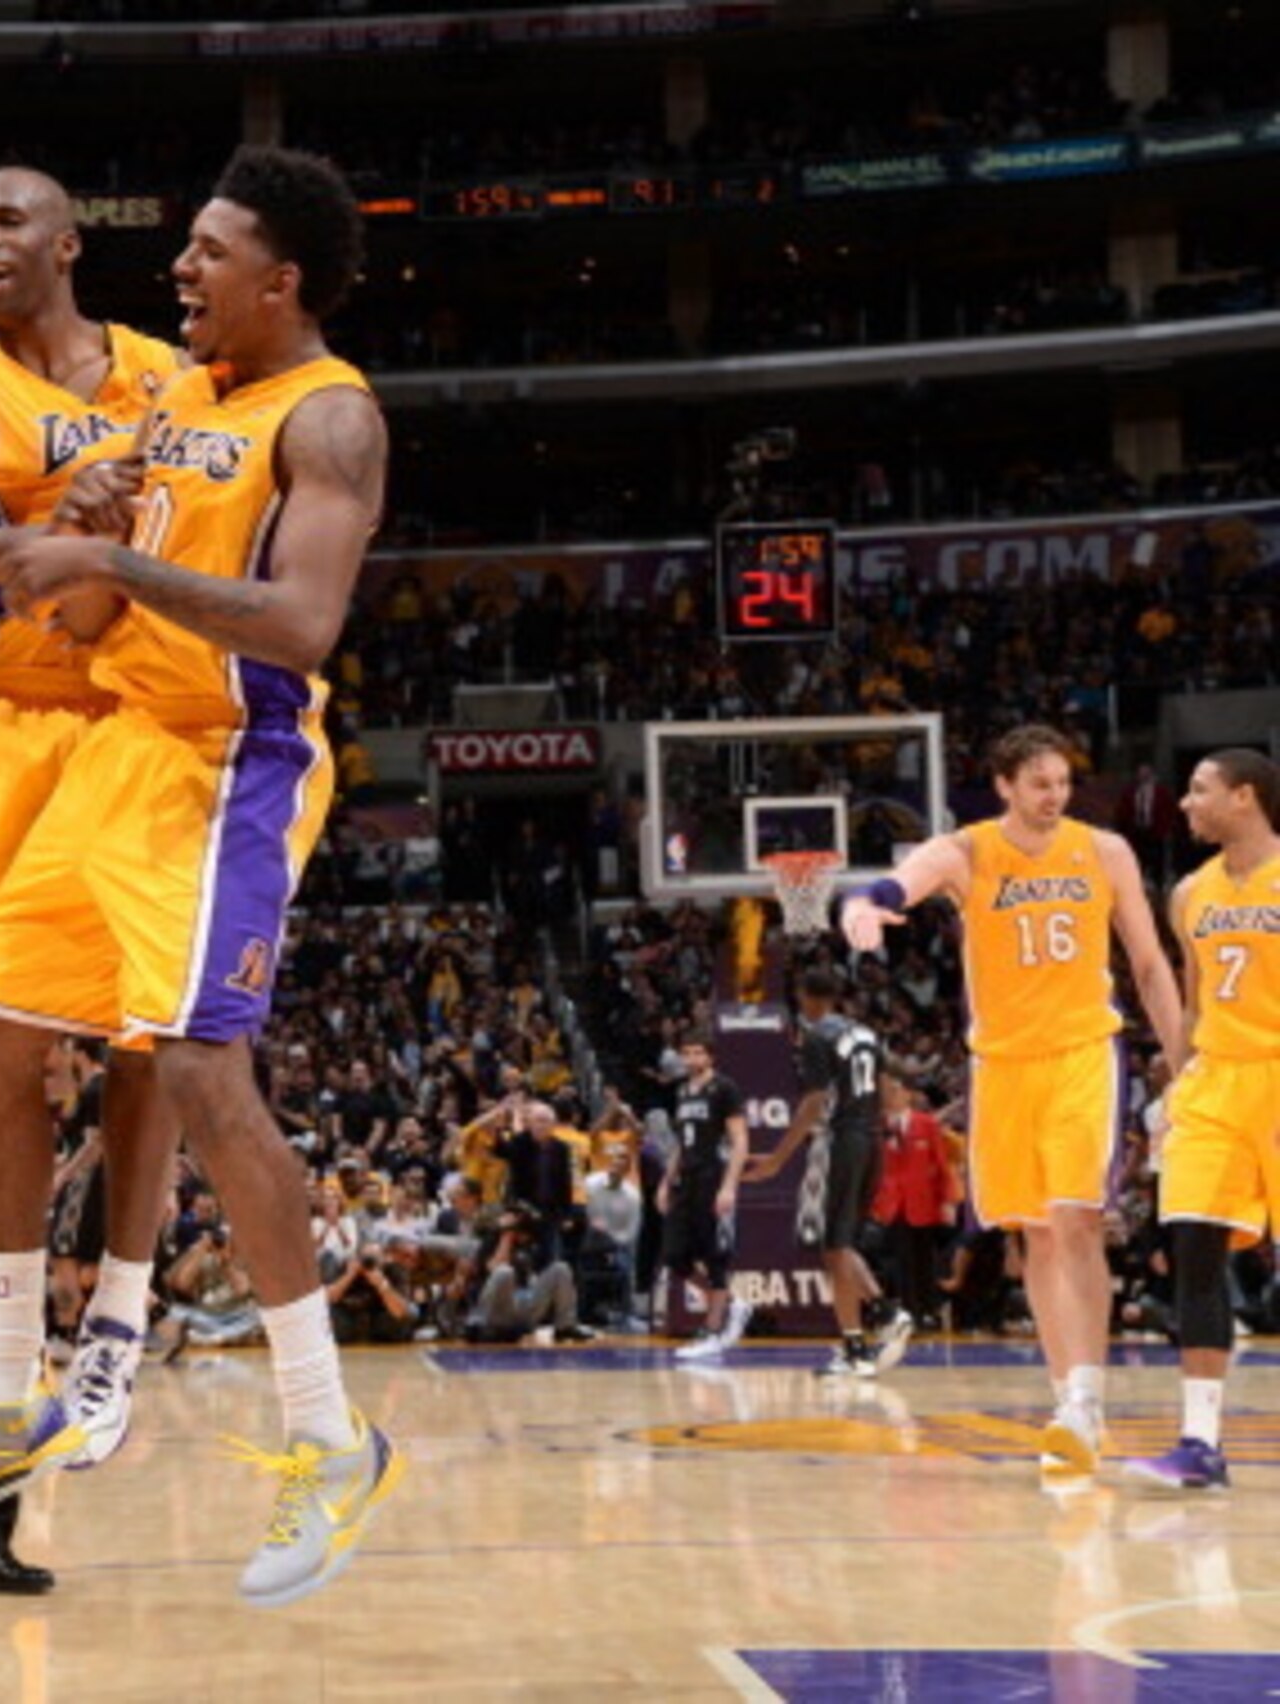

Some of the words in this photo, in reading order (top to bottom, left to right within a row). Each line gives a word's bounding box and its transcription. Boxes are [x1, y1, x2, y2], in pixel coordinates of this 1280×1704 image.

[72, 198, 161, 228] APLES
[36, 412, 136, 476] LAK
[739, 571, 813, 627] 24
[431, 732, 595, 767] TOYOTA
[992, 875, 1092, 911] LAKERS
[1015, 911, 1078, 966] 16
[1216, 943, 1247, 1000] 7
[728, 1270, 788, 1307] NBA
